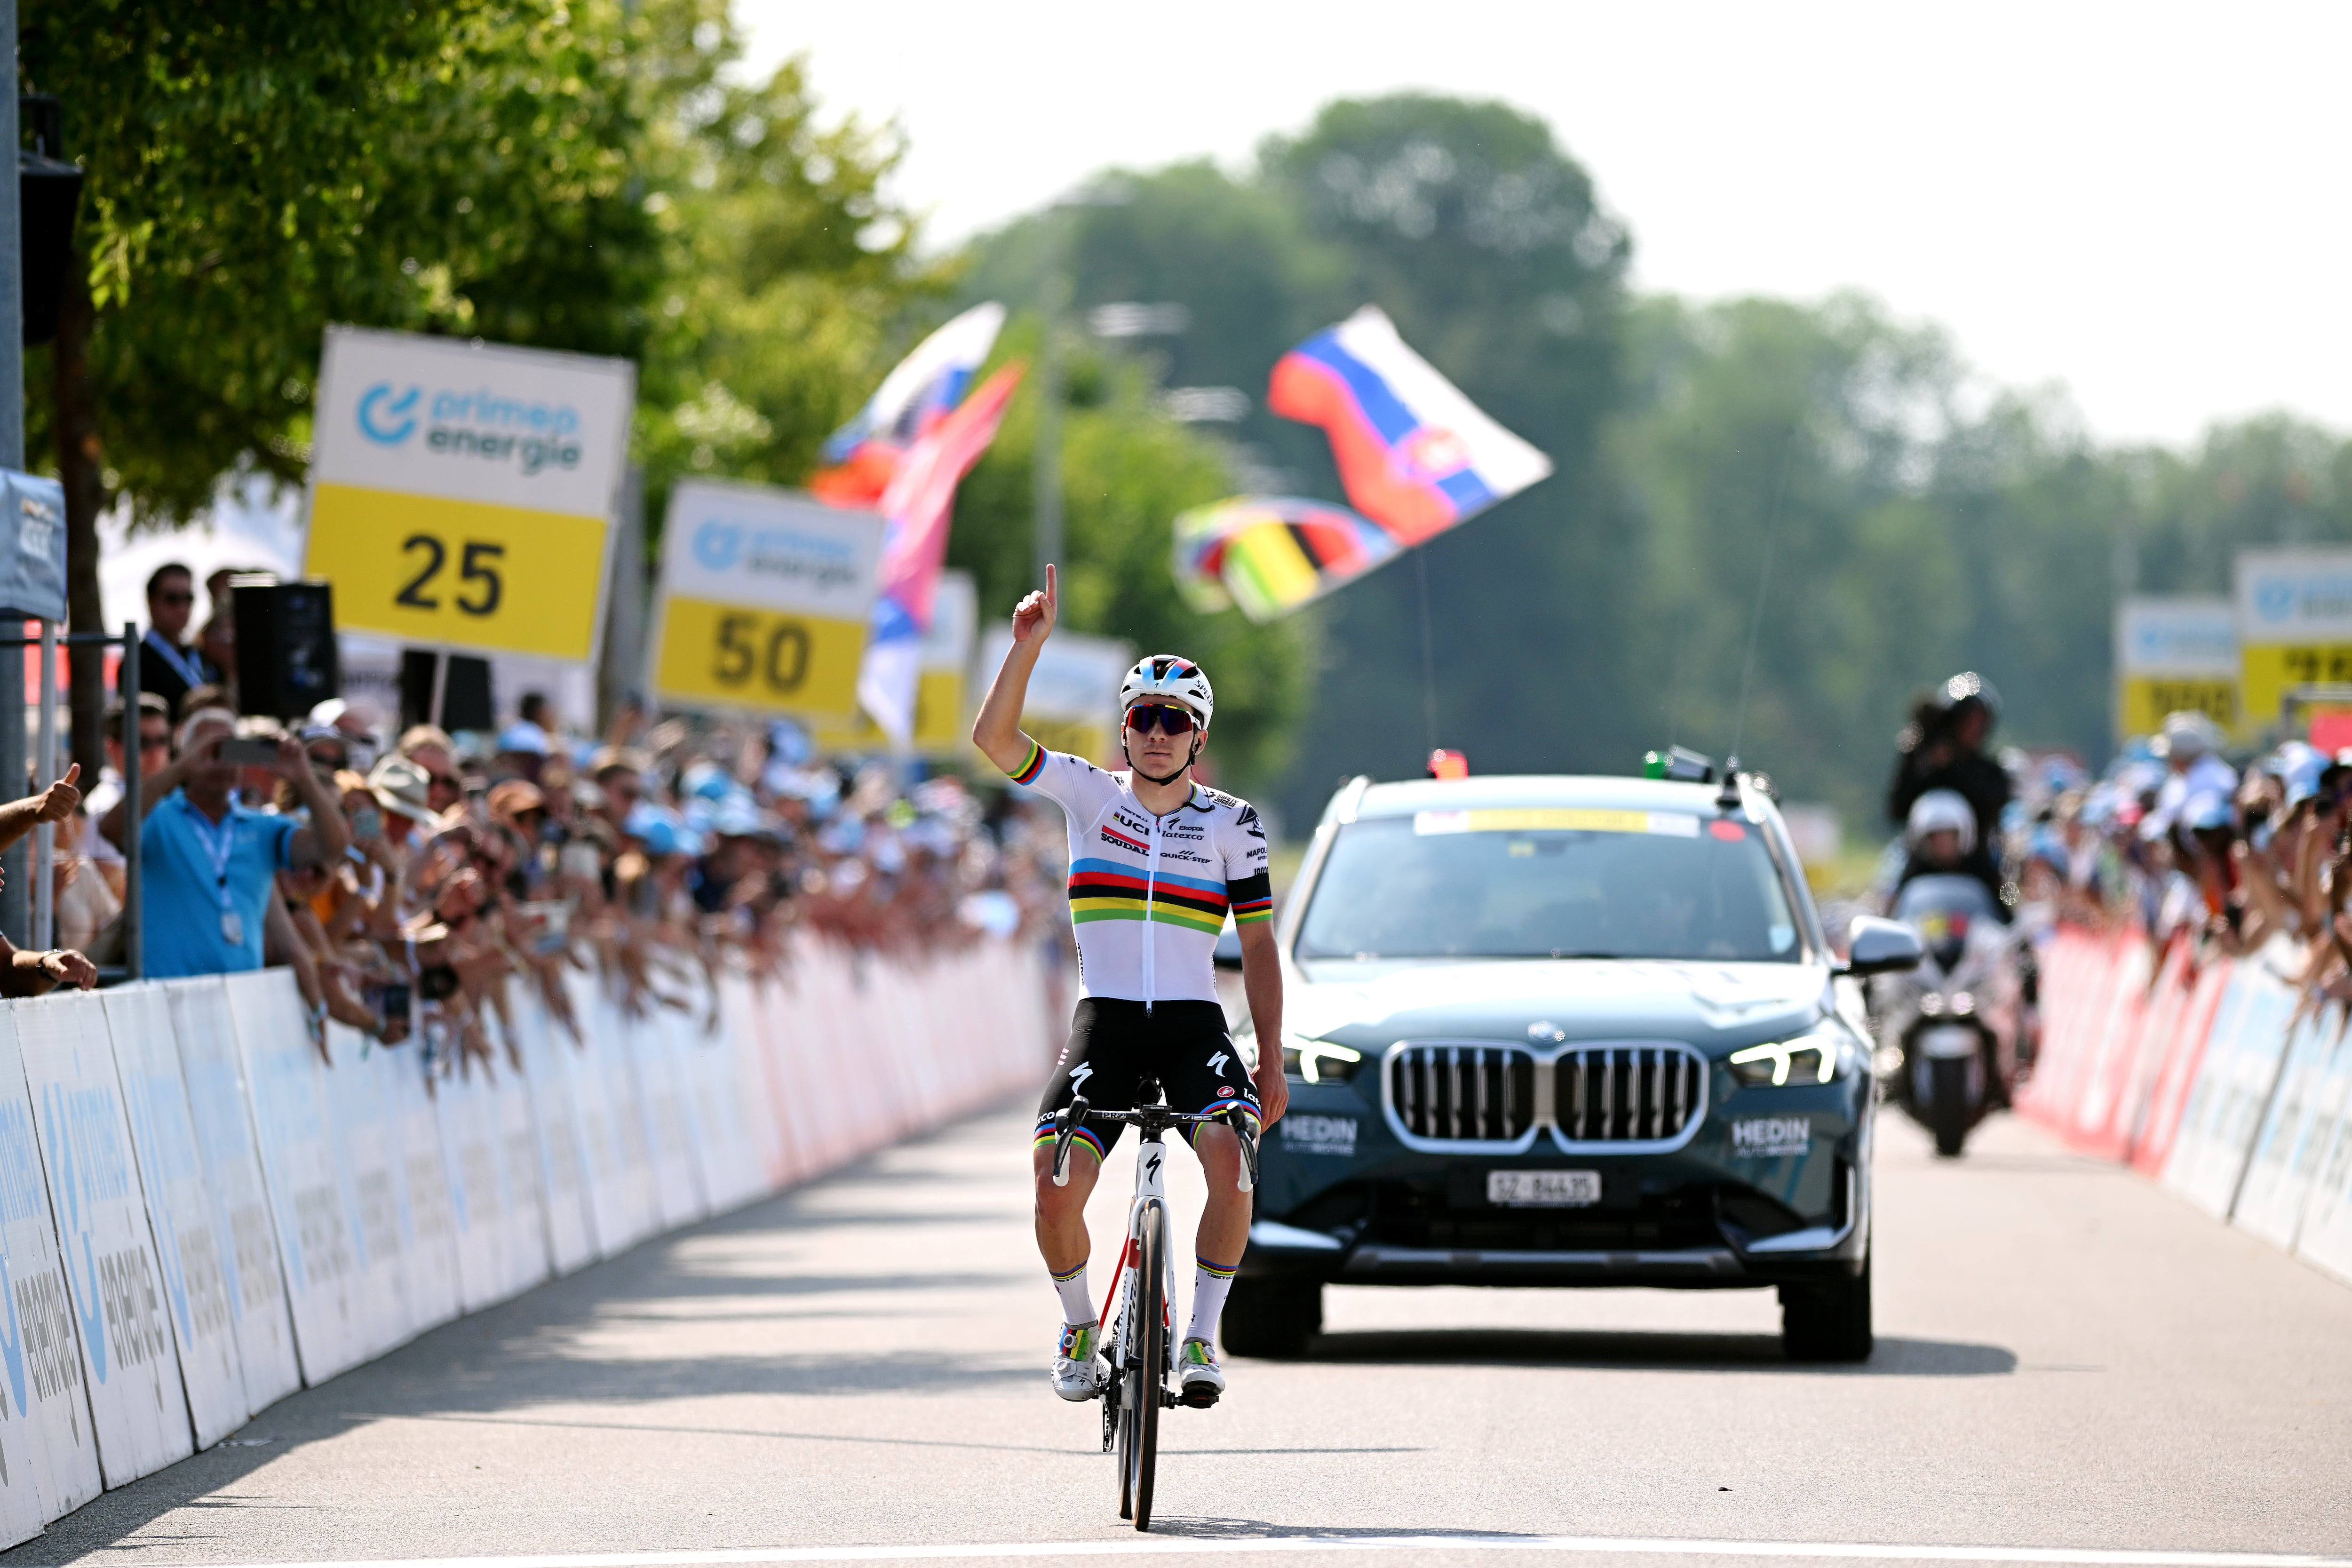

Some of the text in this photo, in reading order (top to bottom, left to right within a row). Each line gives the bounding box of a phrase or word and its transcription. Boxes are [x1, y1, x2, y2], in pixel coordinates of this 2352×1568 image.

[394, 533, 507, 618] 25
[714, 613, 813, 693] 50
[1214, 797, 1236, 807] JOGGER
[1120, 815, 1149, 836] UCI
[1162, 830, 1203, 840] latexco
[1101, 833, 1149, 857] SOUDAL
[1280, 1115, 1358, 1142] HEDIN
[1732, 1117, 1810, 1146] HEDIN
[99, 1205, 166, 1413] energie
[15, 1223, 79, 1448] energie
